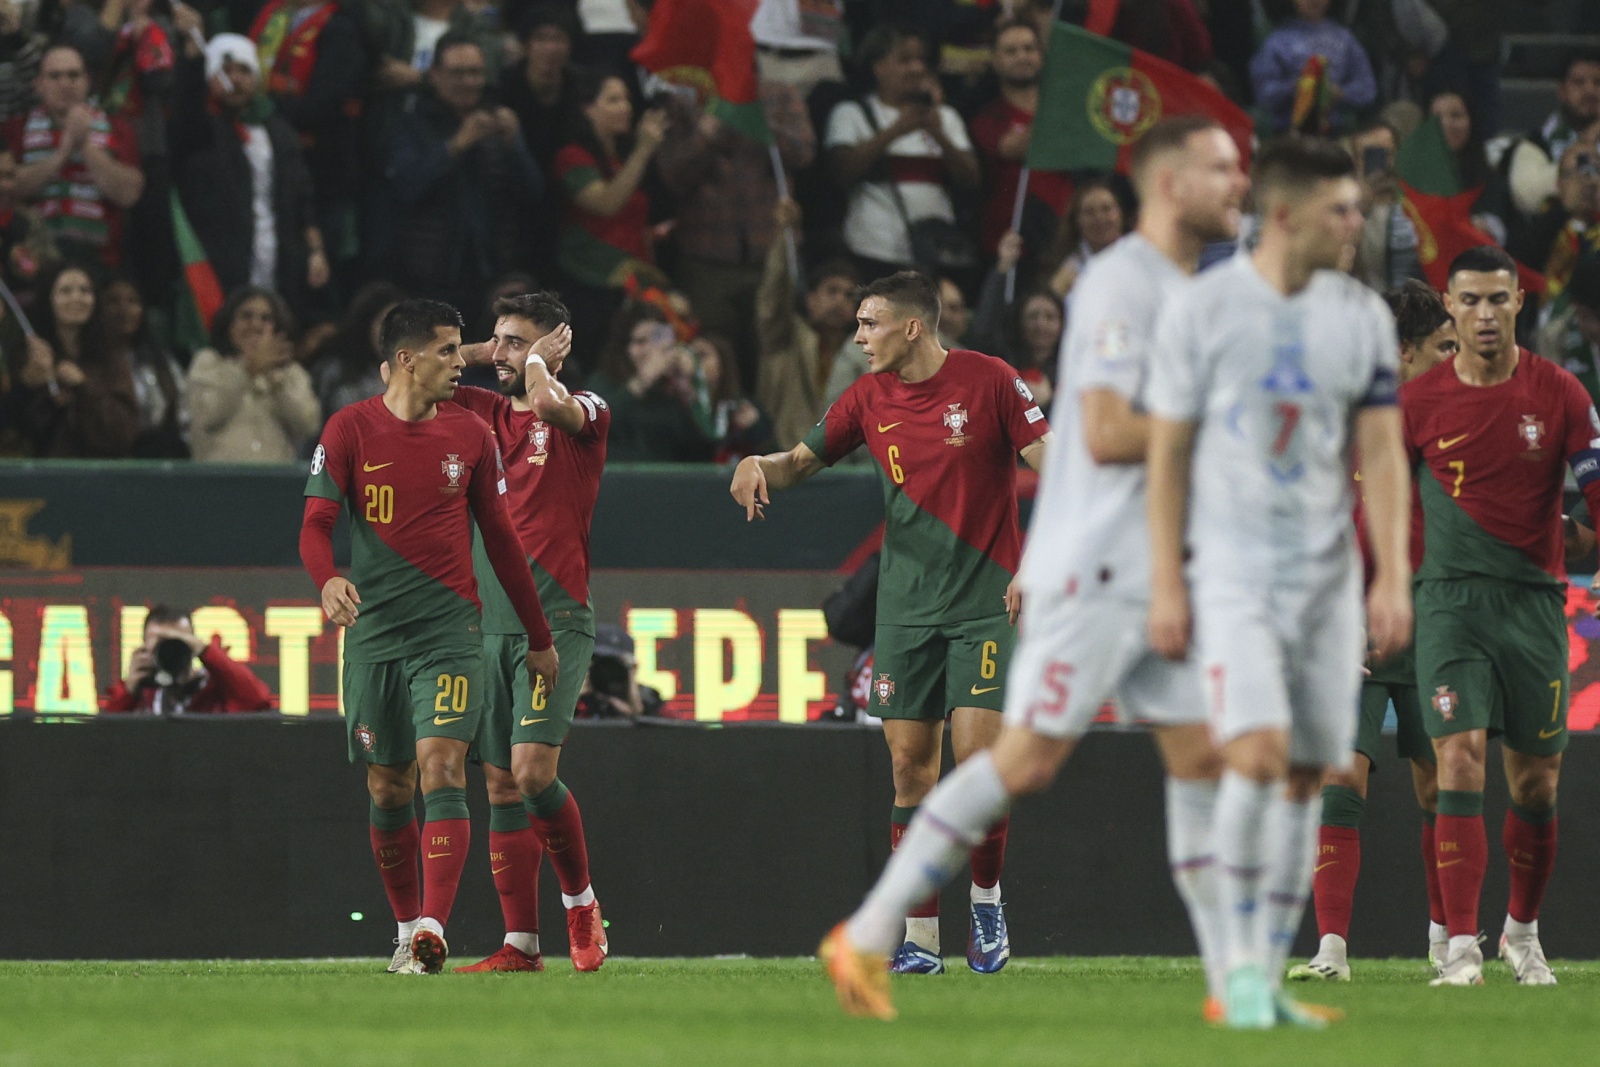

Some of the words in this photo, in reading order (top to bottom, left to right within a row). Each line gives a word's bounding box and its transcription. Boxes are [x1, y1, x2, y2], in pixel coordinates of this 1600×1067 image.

[1274, 400, 1302, 456] 7
[887, 444, 906, 485] 6
[1448, 460, 1465, 498] 7
[364, 484, 395, 525] 20
[980, 640, 998, 680] 6
[434, 673, 469, 713] 20
[1548, 679, 1562, 723] 7
